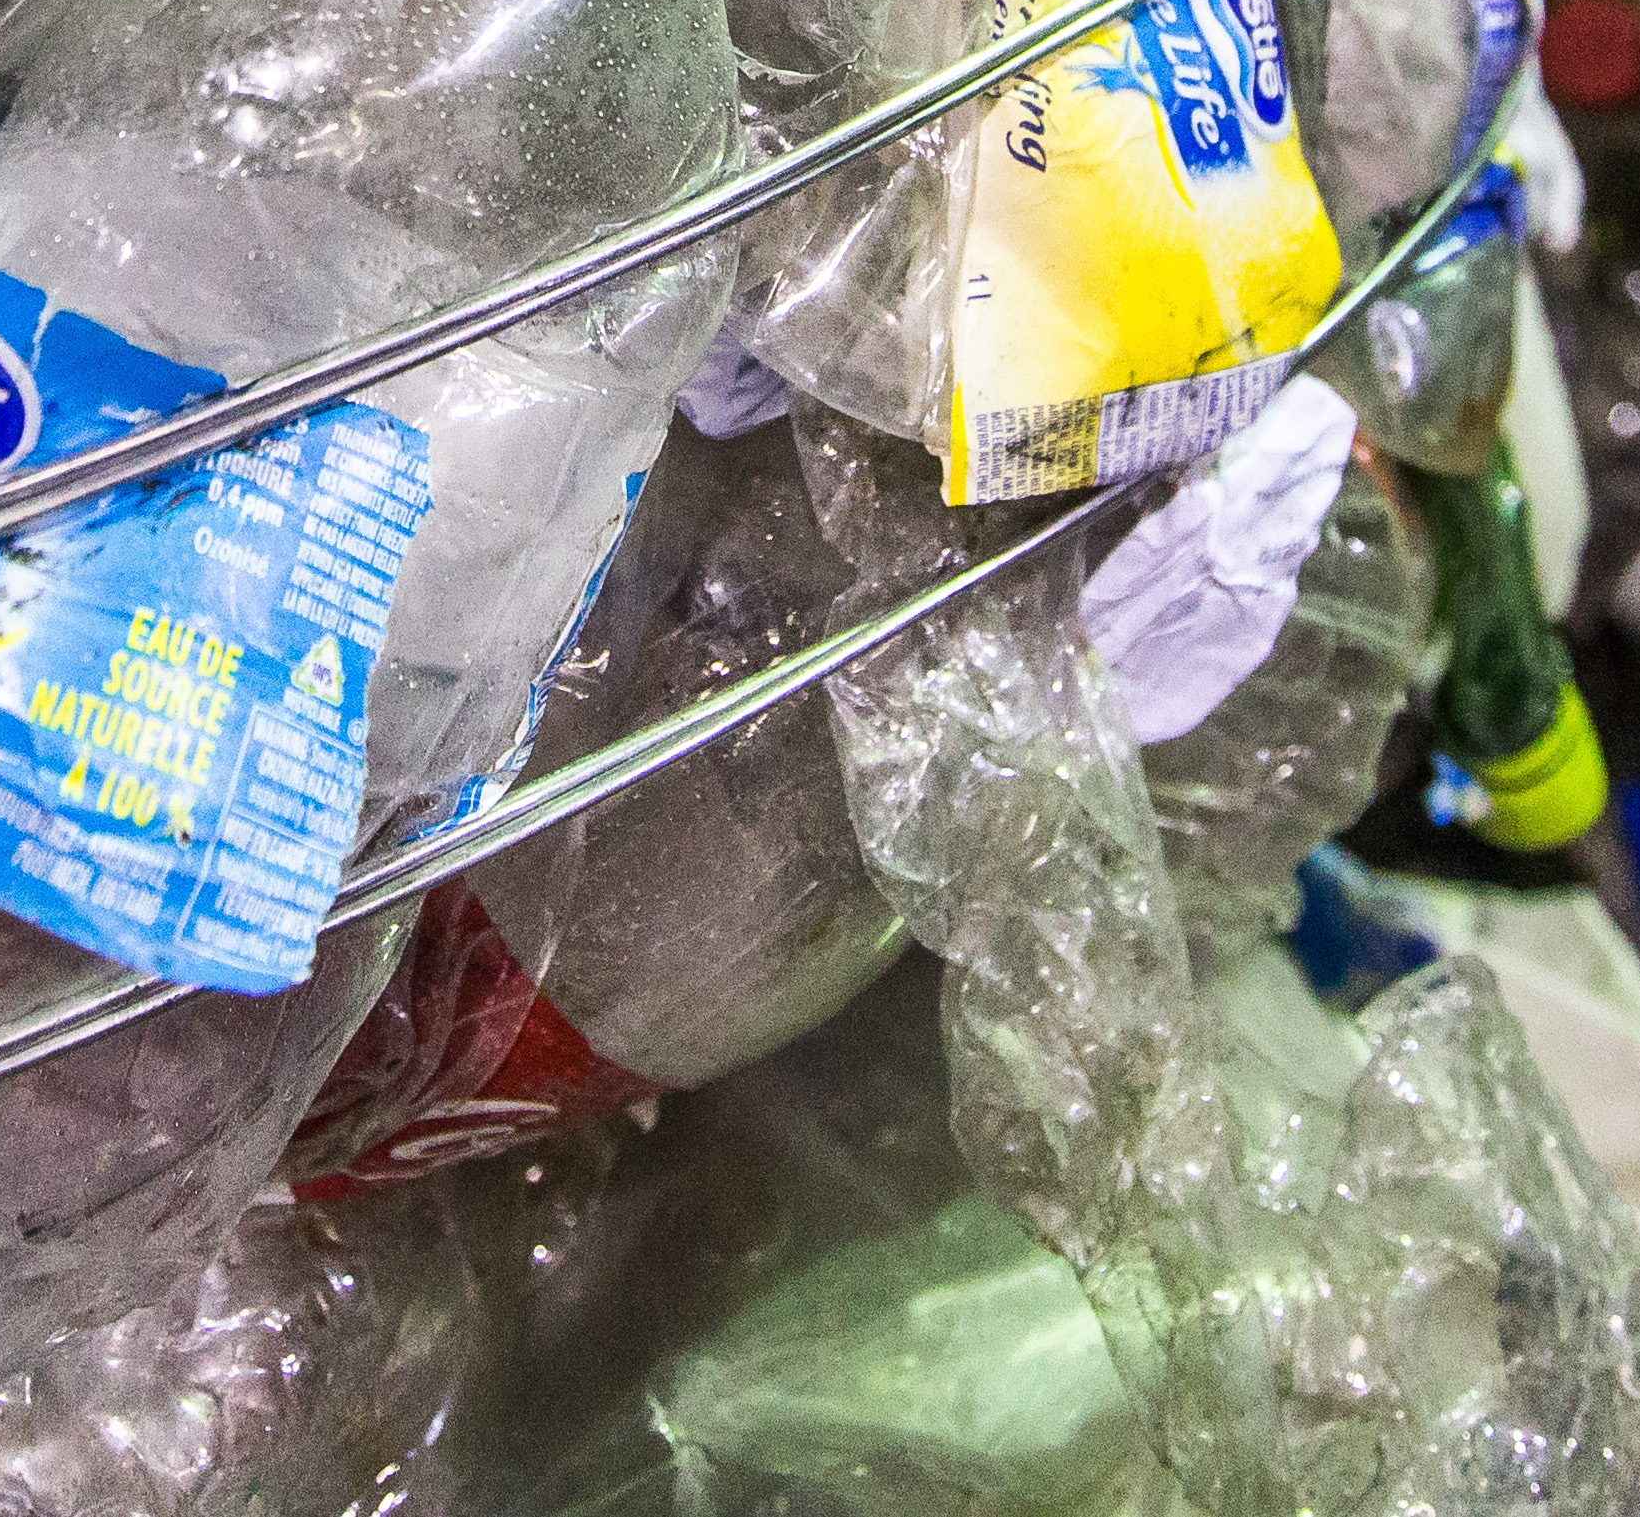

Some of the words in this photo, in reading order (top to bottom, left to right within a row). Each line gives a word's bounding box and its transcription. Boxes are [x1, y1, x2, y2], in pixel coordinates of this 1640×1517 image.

[1158, 33, 1227, 151] Life
[126, 605, 197, 666] EAU
[197, 636, 245, 689] DE
[28, 678, 216, 789] NATURELLE
[102, 650, 231, 737] SOURCE
[96, 768, 160, 828] 100
